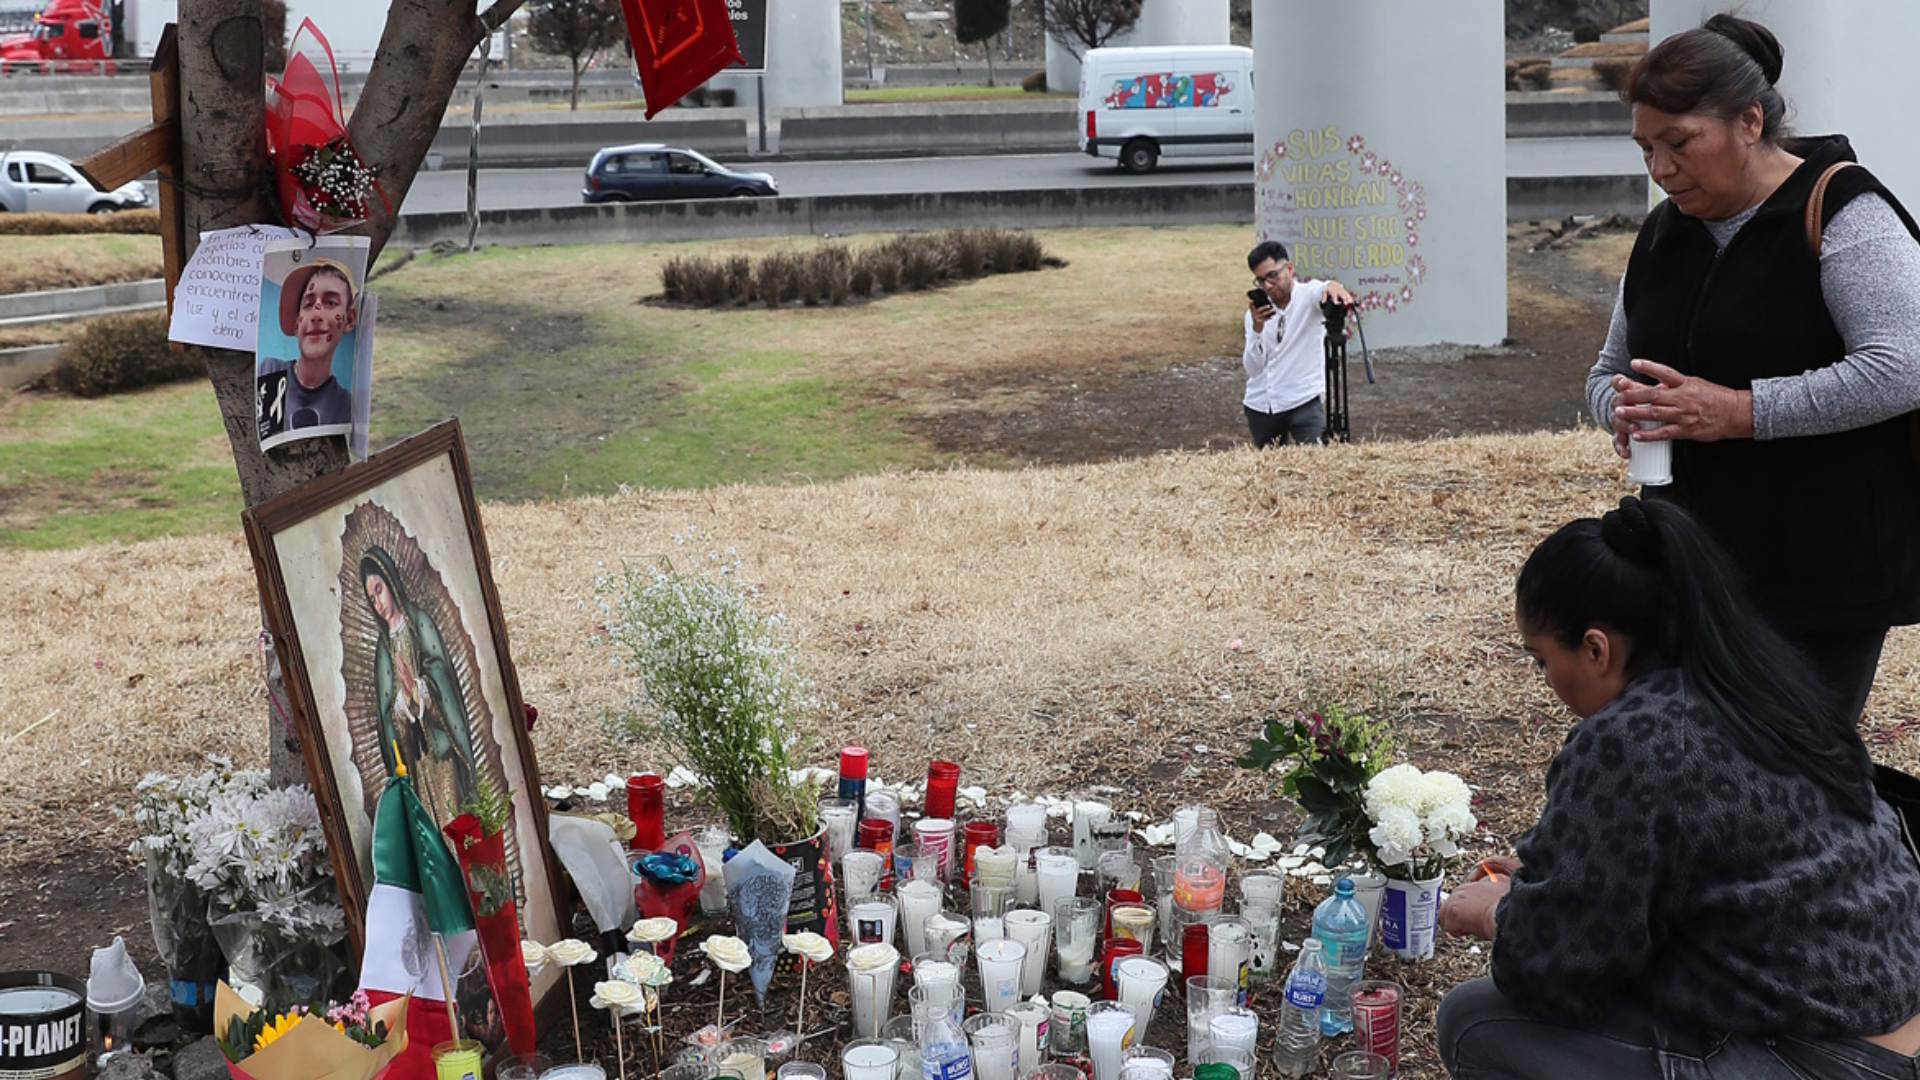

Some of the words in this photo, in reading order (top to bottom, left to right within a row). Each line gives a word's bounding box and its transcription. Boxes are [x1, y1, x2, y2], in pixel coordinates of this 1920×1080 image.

[1287, 125, 1341, 160] SUS
[1282, 160, 1350, 184] VIDAS
[1294, 181, 1386, 209] HONRAN
[1303, 215, 1400, 241] NUESTRO
[196, 253, 250, 268] nombres
[1293, 242, 1403, 269] RECUERDO
[188, 270, 260, 286] conocemos
[227, 308, 239, 321] el
